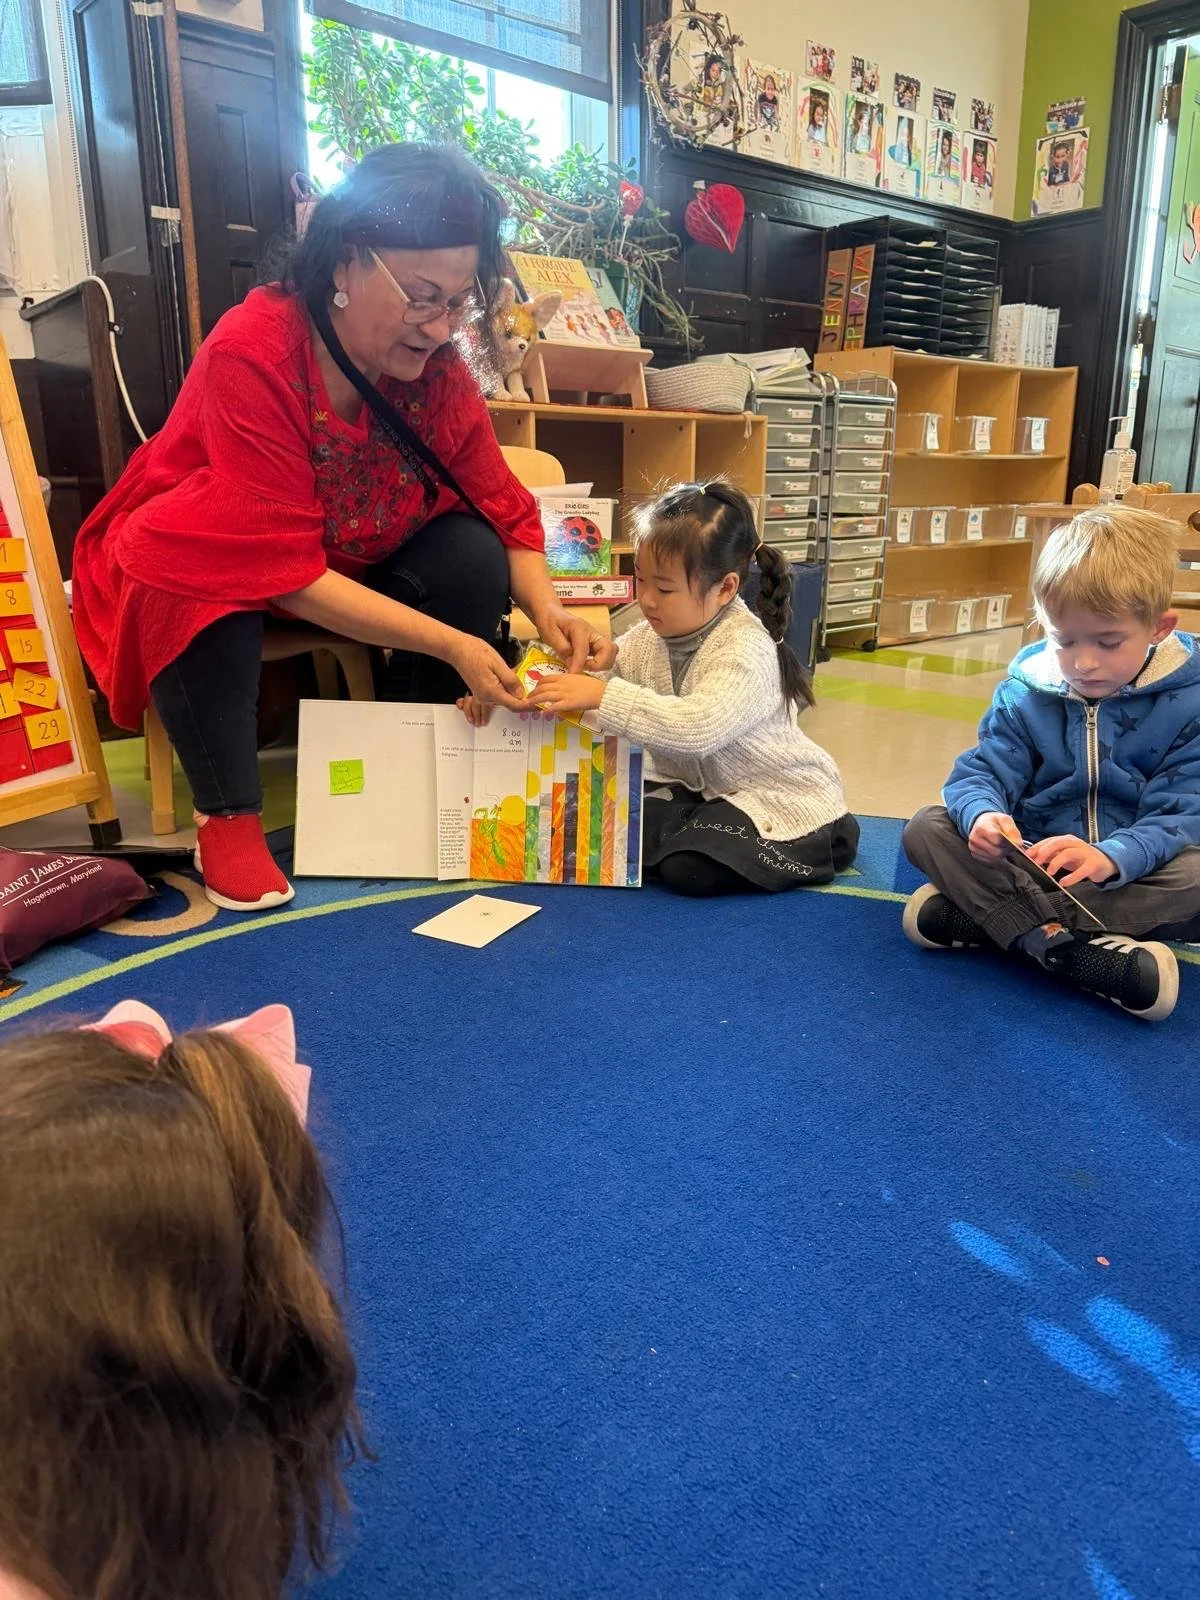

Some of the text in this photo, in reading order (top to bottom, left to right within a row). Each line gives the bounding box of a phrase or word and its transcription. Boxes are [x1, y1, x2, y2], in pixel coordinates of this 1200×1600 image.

[530, 257, 577, 273] FORGIVE
[537, 270, 575, 285] ALEX
[822, 269, 848, 343] JENNY
[843, 247, 873, 351] EPHRAIM
[6, 589, 17, 605] 8
[19, 638, 33, 656] 15
[24, 679, 47, 698] 22
[38, 718, 60, 740] 29
[502, 727, 521, 737] 8:00
[30, 859, 64, 884] JAMES
[23, 864, 103, 907] Hagerstown, Maryland
